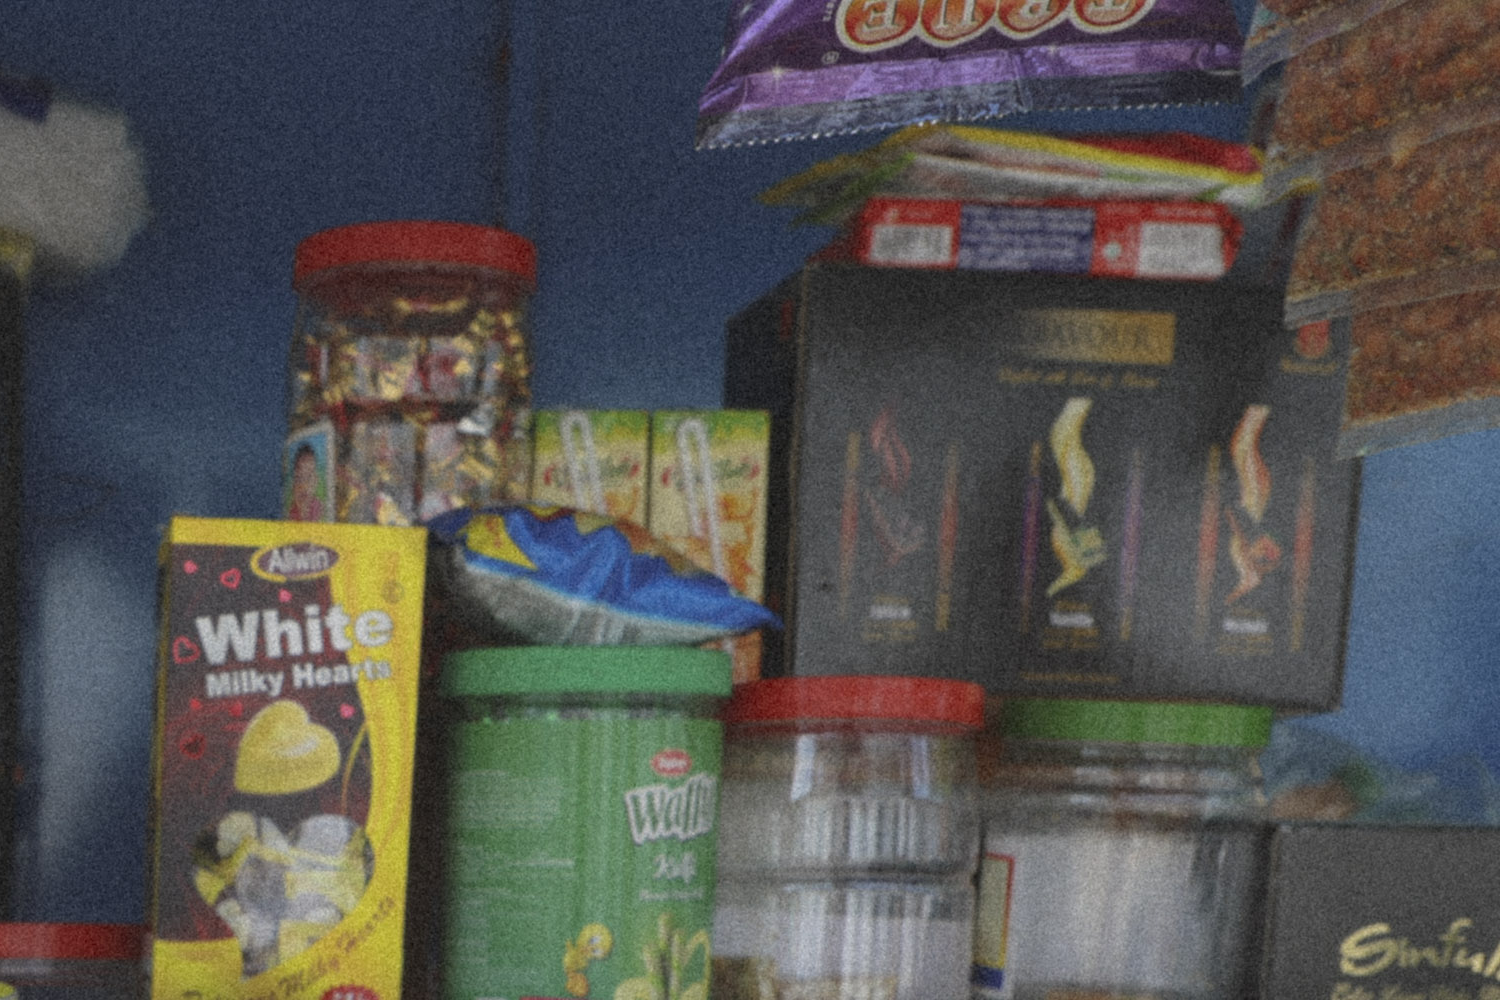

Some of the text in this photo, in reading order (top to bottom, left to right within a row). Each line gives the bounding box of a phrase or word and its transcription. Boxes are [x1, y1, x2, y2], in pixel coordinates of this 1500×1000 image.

[268, 548, 330, 574] Allwin
[194, 603, 395, 666] White
[205, 659, 393, 698] Milky Hearts
